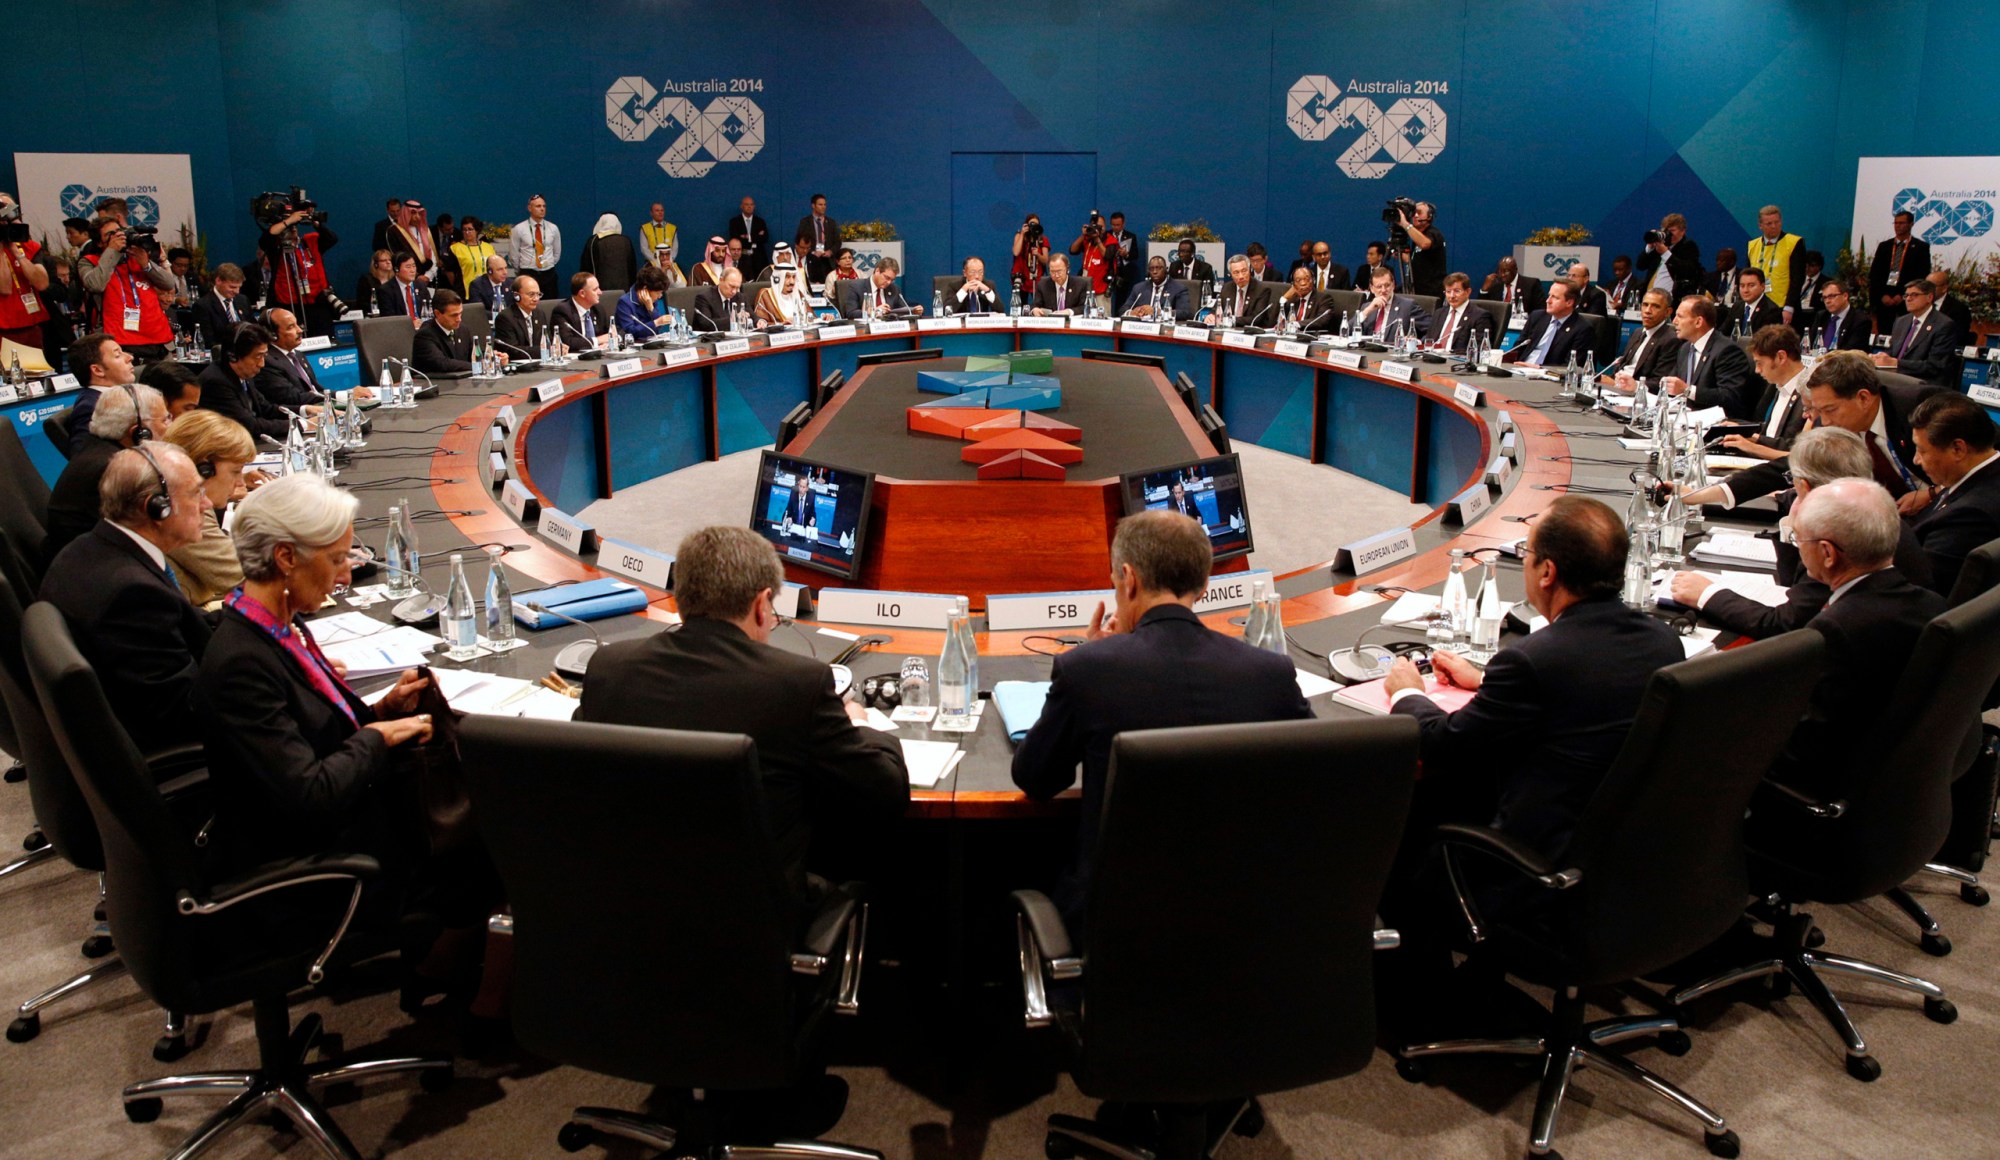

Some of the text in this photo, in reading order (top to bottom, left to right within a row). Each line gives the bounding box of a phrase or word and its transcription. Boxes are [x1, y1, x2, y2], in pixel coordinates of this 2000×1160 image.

[664, 79, 764, 93] Australia 2014
[1347, 79, 1449, 94] Australia 2014
[605, 76, 765, 178] G20
[1286, 75, 1447, 179] G20
[137, 185, 157, 193] 2014
[1930, 189, 1997, 198] Australia 2014
[618, 363, 632, 371] MEXICO
[1470, 497, 1482, 512] CHINA
[547, 520, 572, 541] GERMANY
[1360, 539, 1409, 565] EUROPEAN UNION
[622, 555, 643, 572] OECD
[1194, 584, 1243, 604] RANCE
[877, 603, 901, 618] ILO
[1048, 604, 1078, 619] FSB
